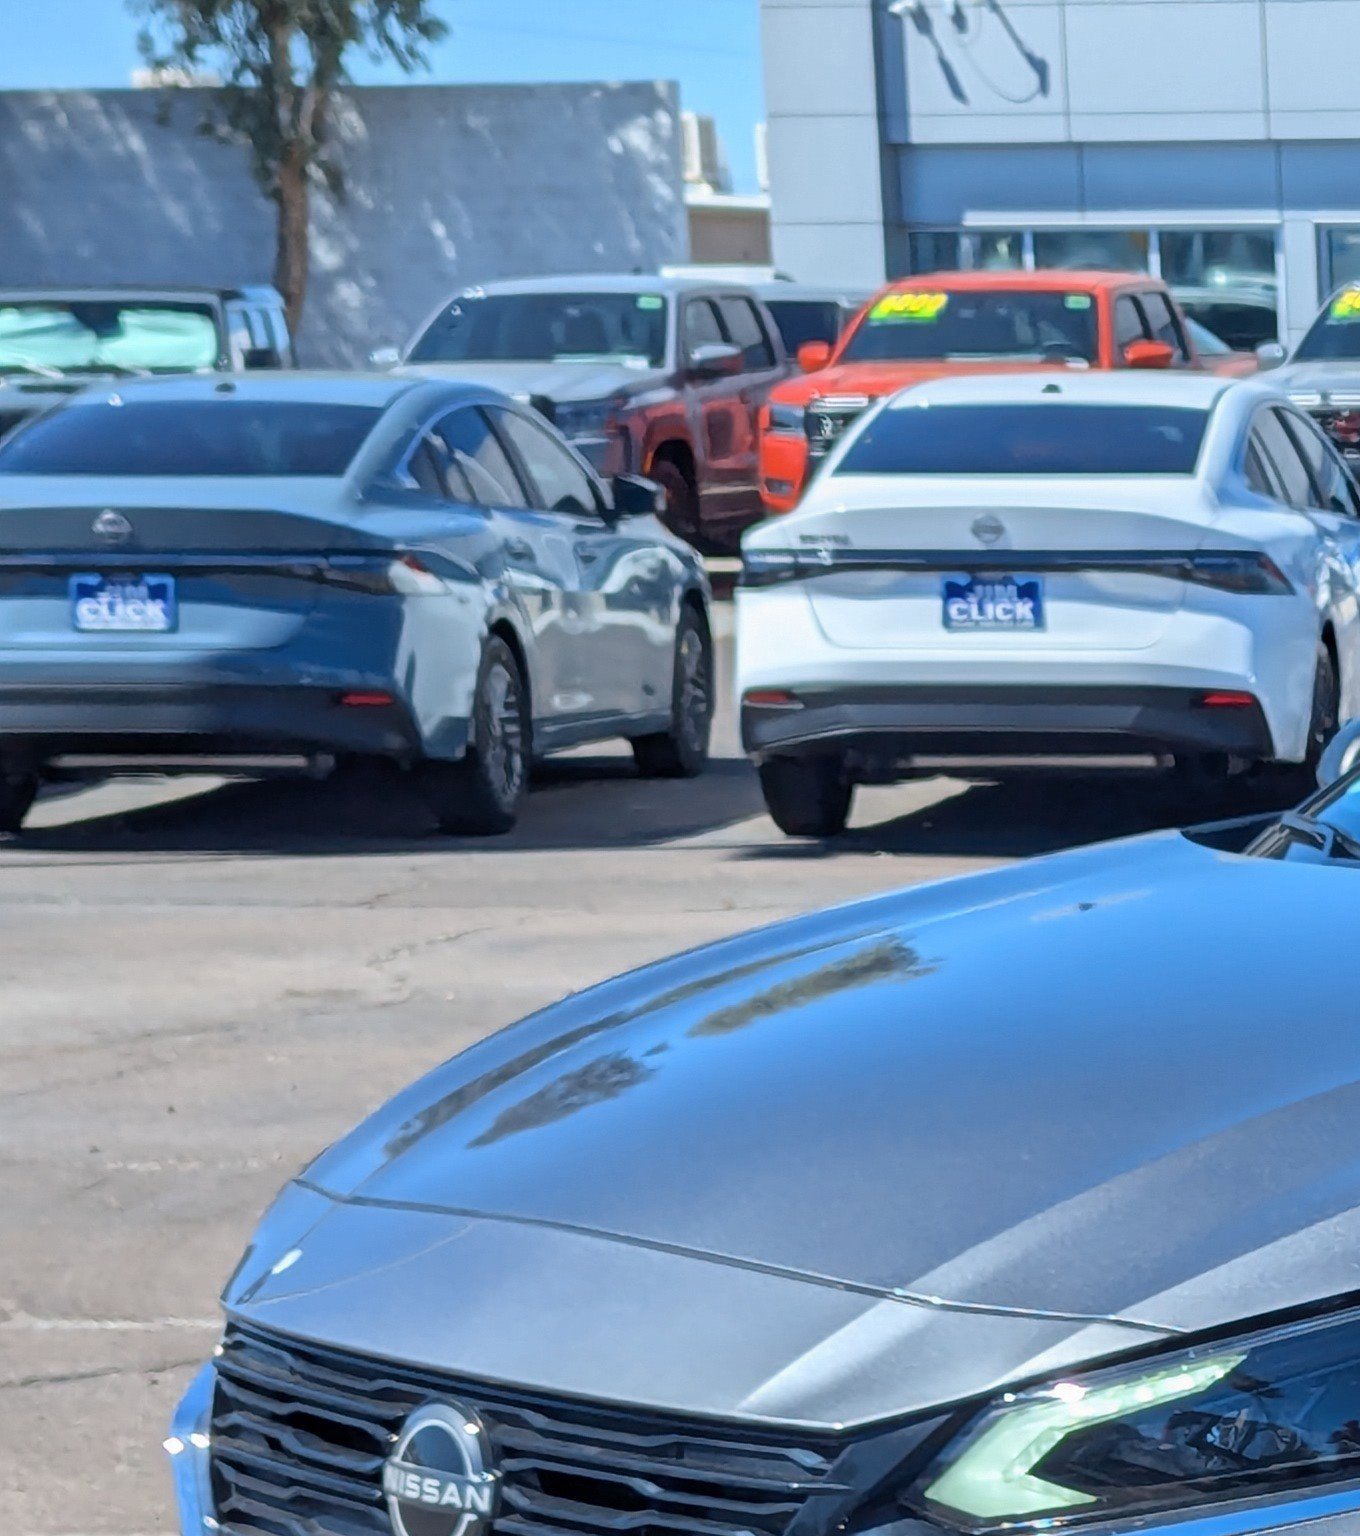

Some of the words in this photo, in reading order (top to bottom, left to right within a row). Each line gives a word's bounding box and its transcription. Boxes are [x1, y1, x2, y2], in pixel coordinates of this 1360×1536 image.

[966, 584, 1018, 601] JIM
[948, 598, 1034, 621] CLICK
[386, 1465, 491, 1513] ISSAN
